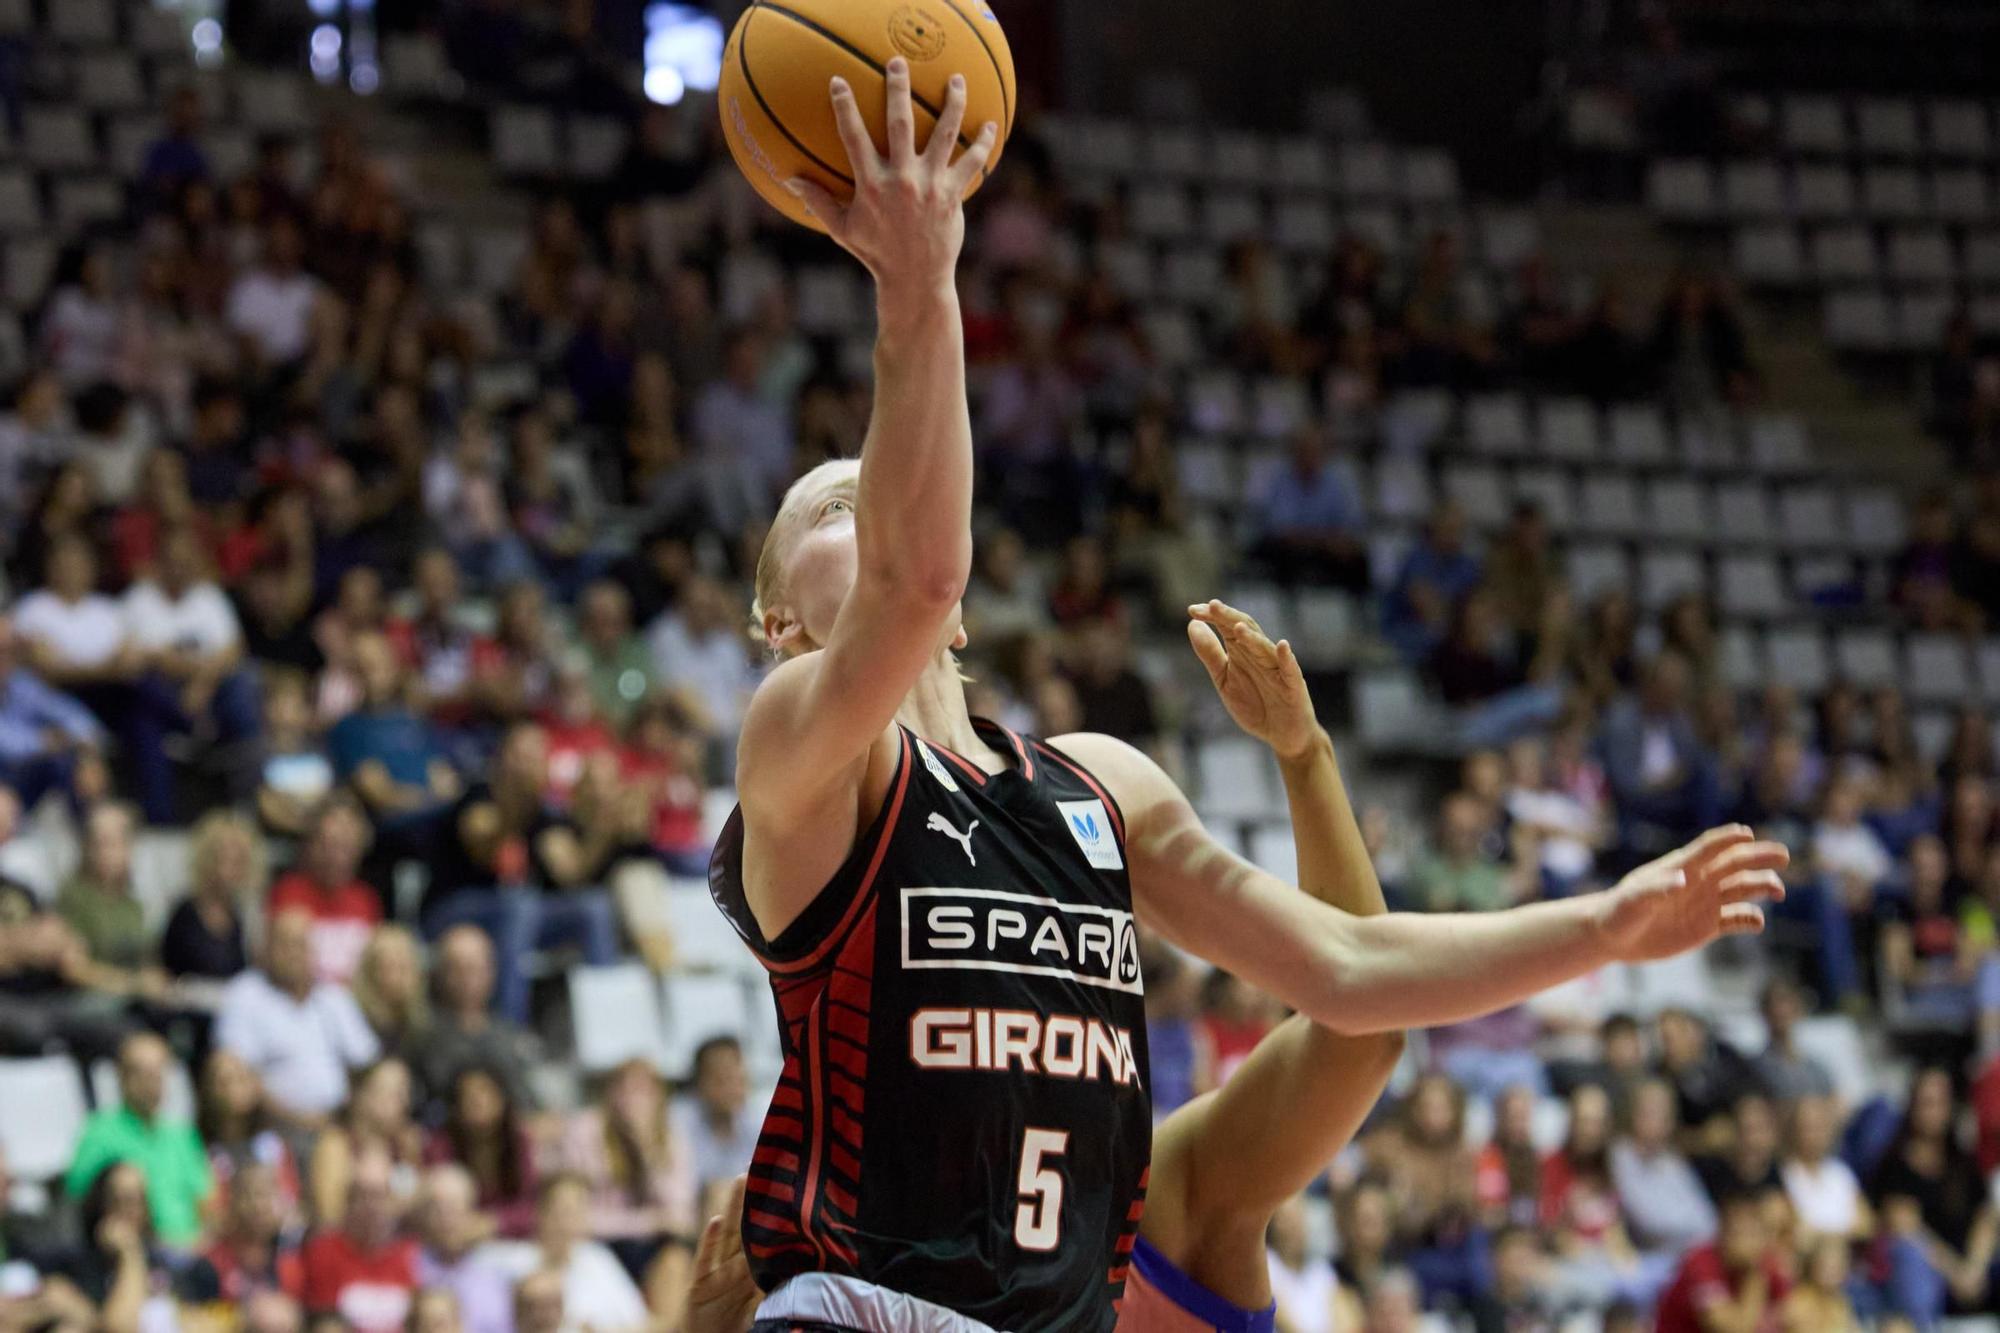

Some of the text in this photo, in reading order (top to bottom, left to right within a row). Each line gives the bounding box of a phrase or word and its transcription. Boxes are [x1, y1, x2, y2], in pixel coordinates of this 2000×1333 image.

[927, 906, 1112, 968] SPAR
[910, 1007, 1142, 1090] GIRONA
[1013, 1126, 1069, 1251] 5
